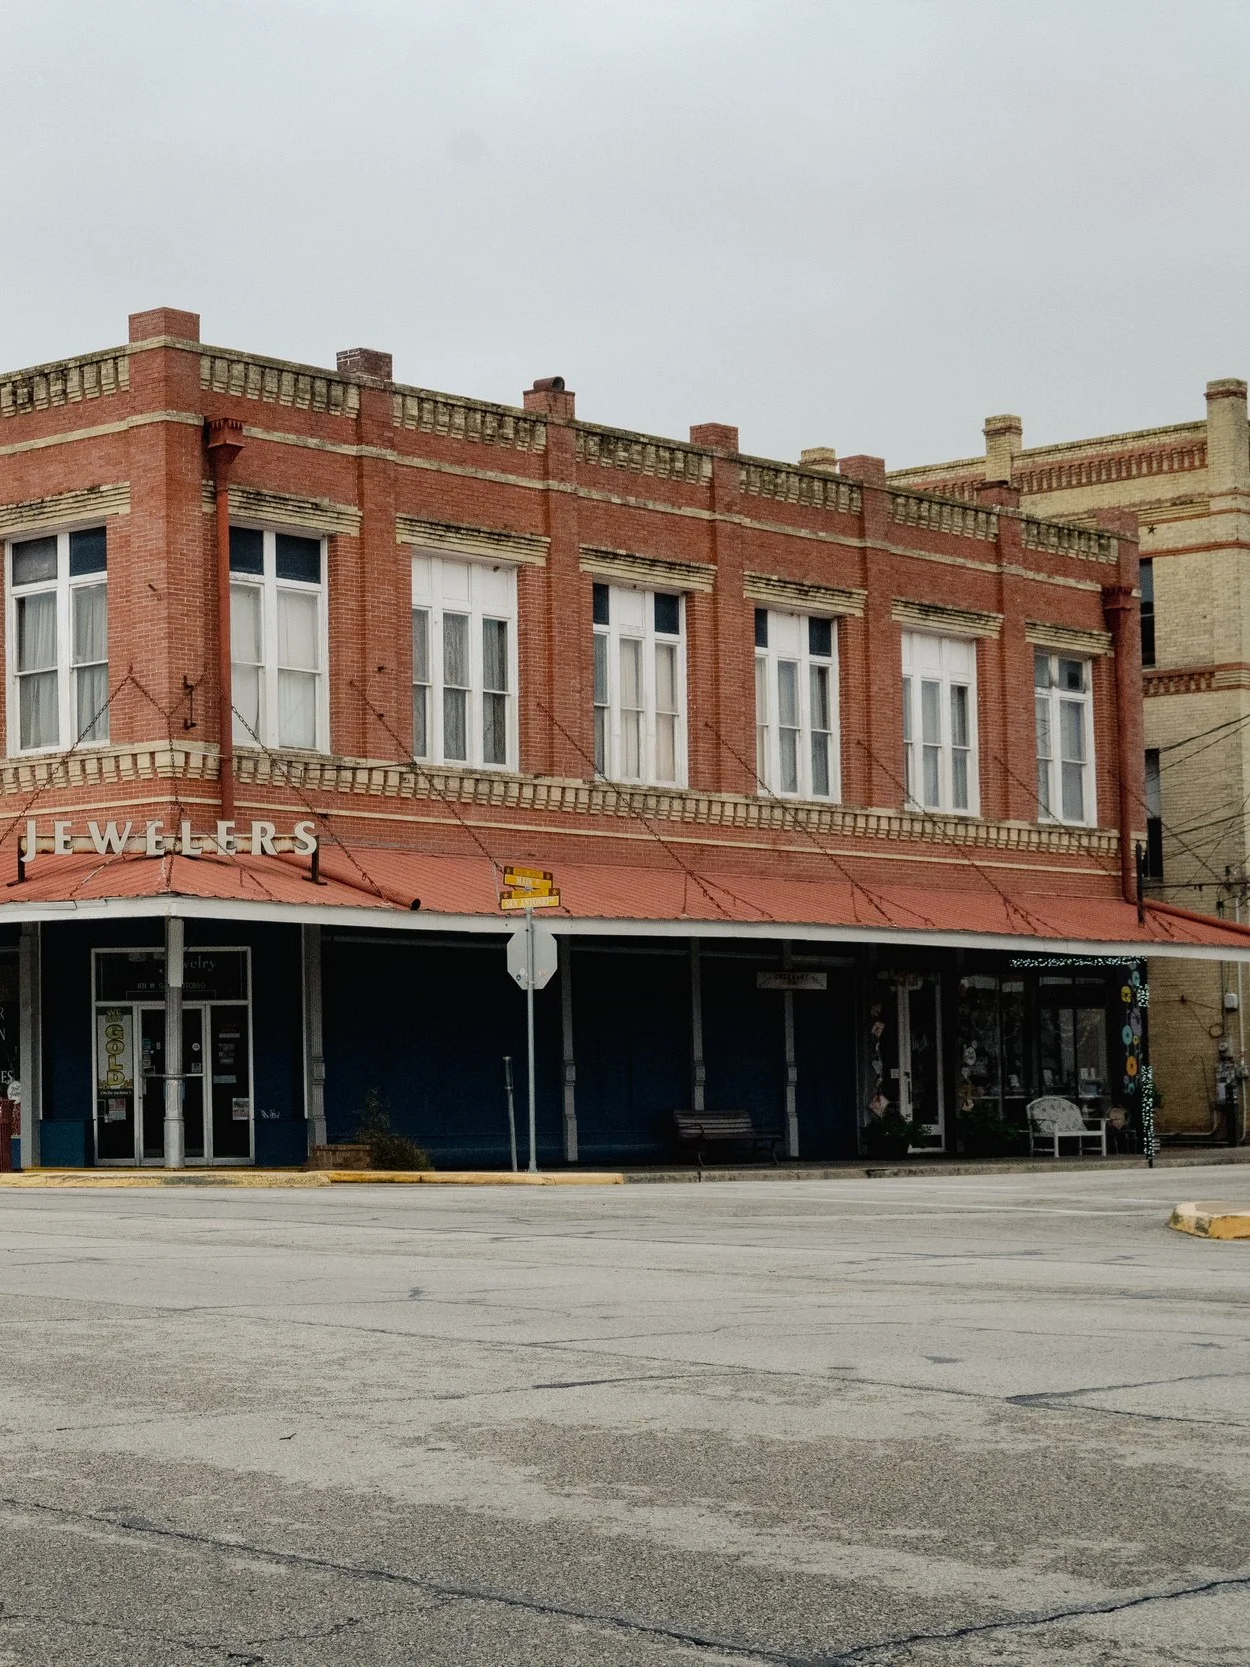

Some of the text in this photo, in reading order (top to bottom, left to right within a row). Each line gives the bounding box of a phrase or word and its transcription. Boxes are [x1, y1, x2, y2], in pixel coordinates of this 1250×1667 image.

[20, 819, 318, 863] JEWELERS
[504, 899, 518, 909] SAN
[105, 1023, 126, 1086] GOLD
